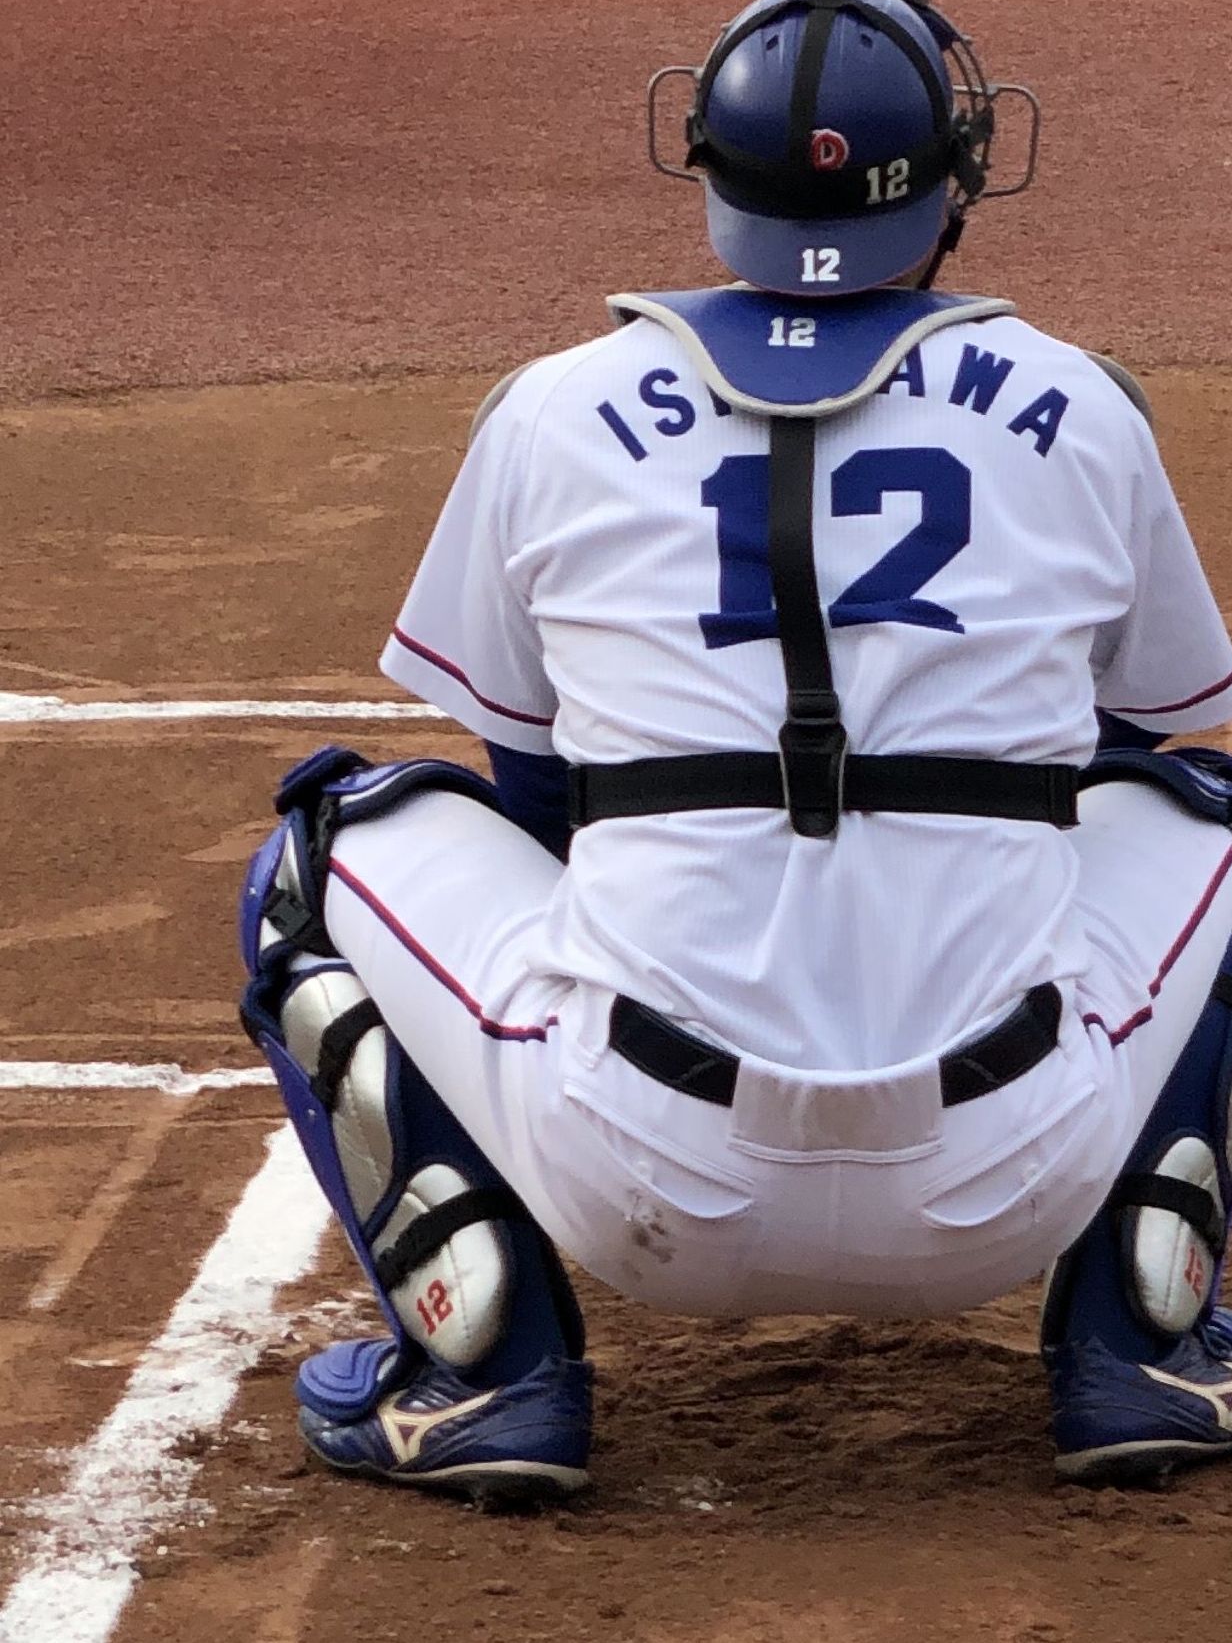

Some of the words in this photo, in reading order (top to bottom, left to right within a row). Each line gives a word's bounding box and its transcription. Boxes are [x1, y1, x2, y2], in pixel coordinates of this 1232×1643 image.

[866, 157, 910, 205] 12
[801, 247, 841, 283] 12
[768, 316, 816, 348] 12
[596, 343, 1069, 458] ISAWA
[698, 447, 972, 649] 12
[416, 1278, 454, 1336] 12
